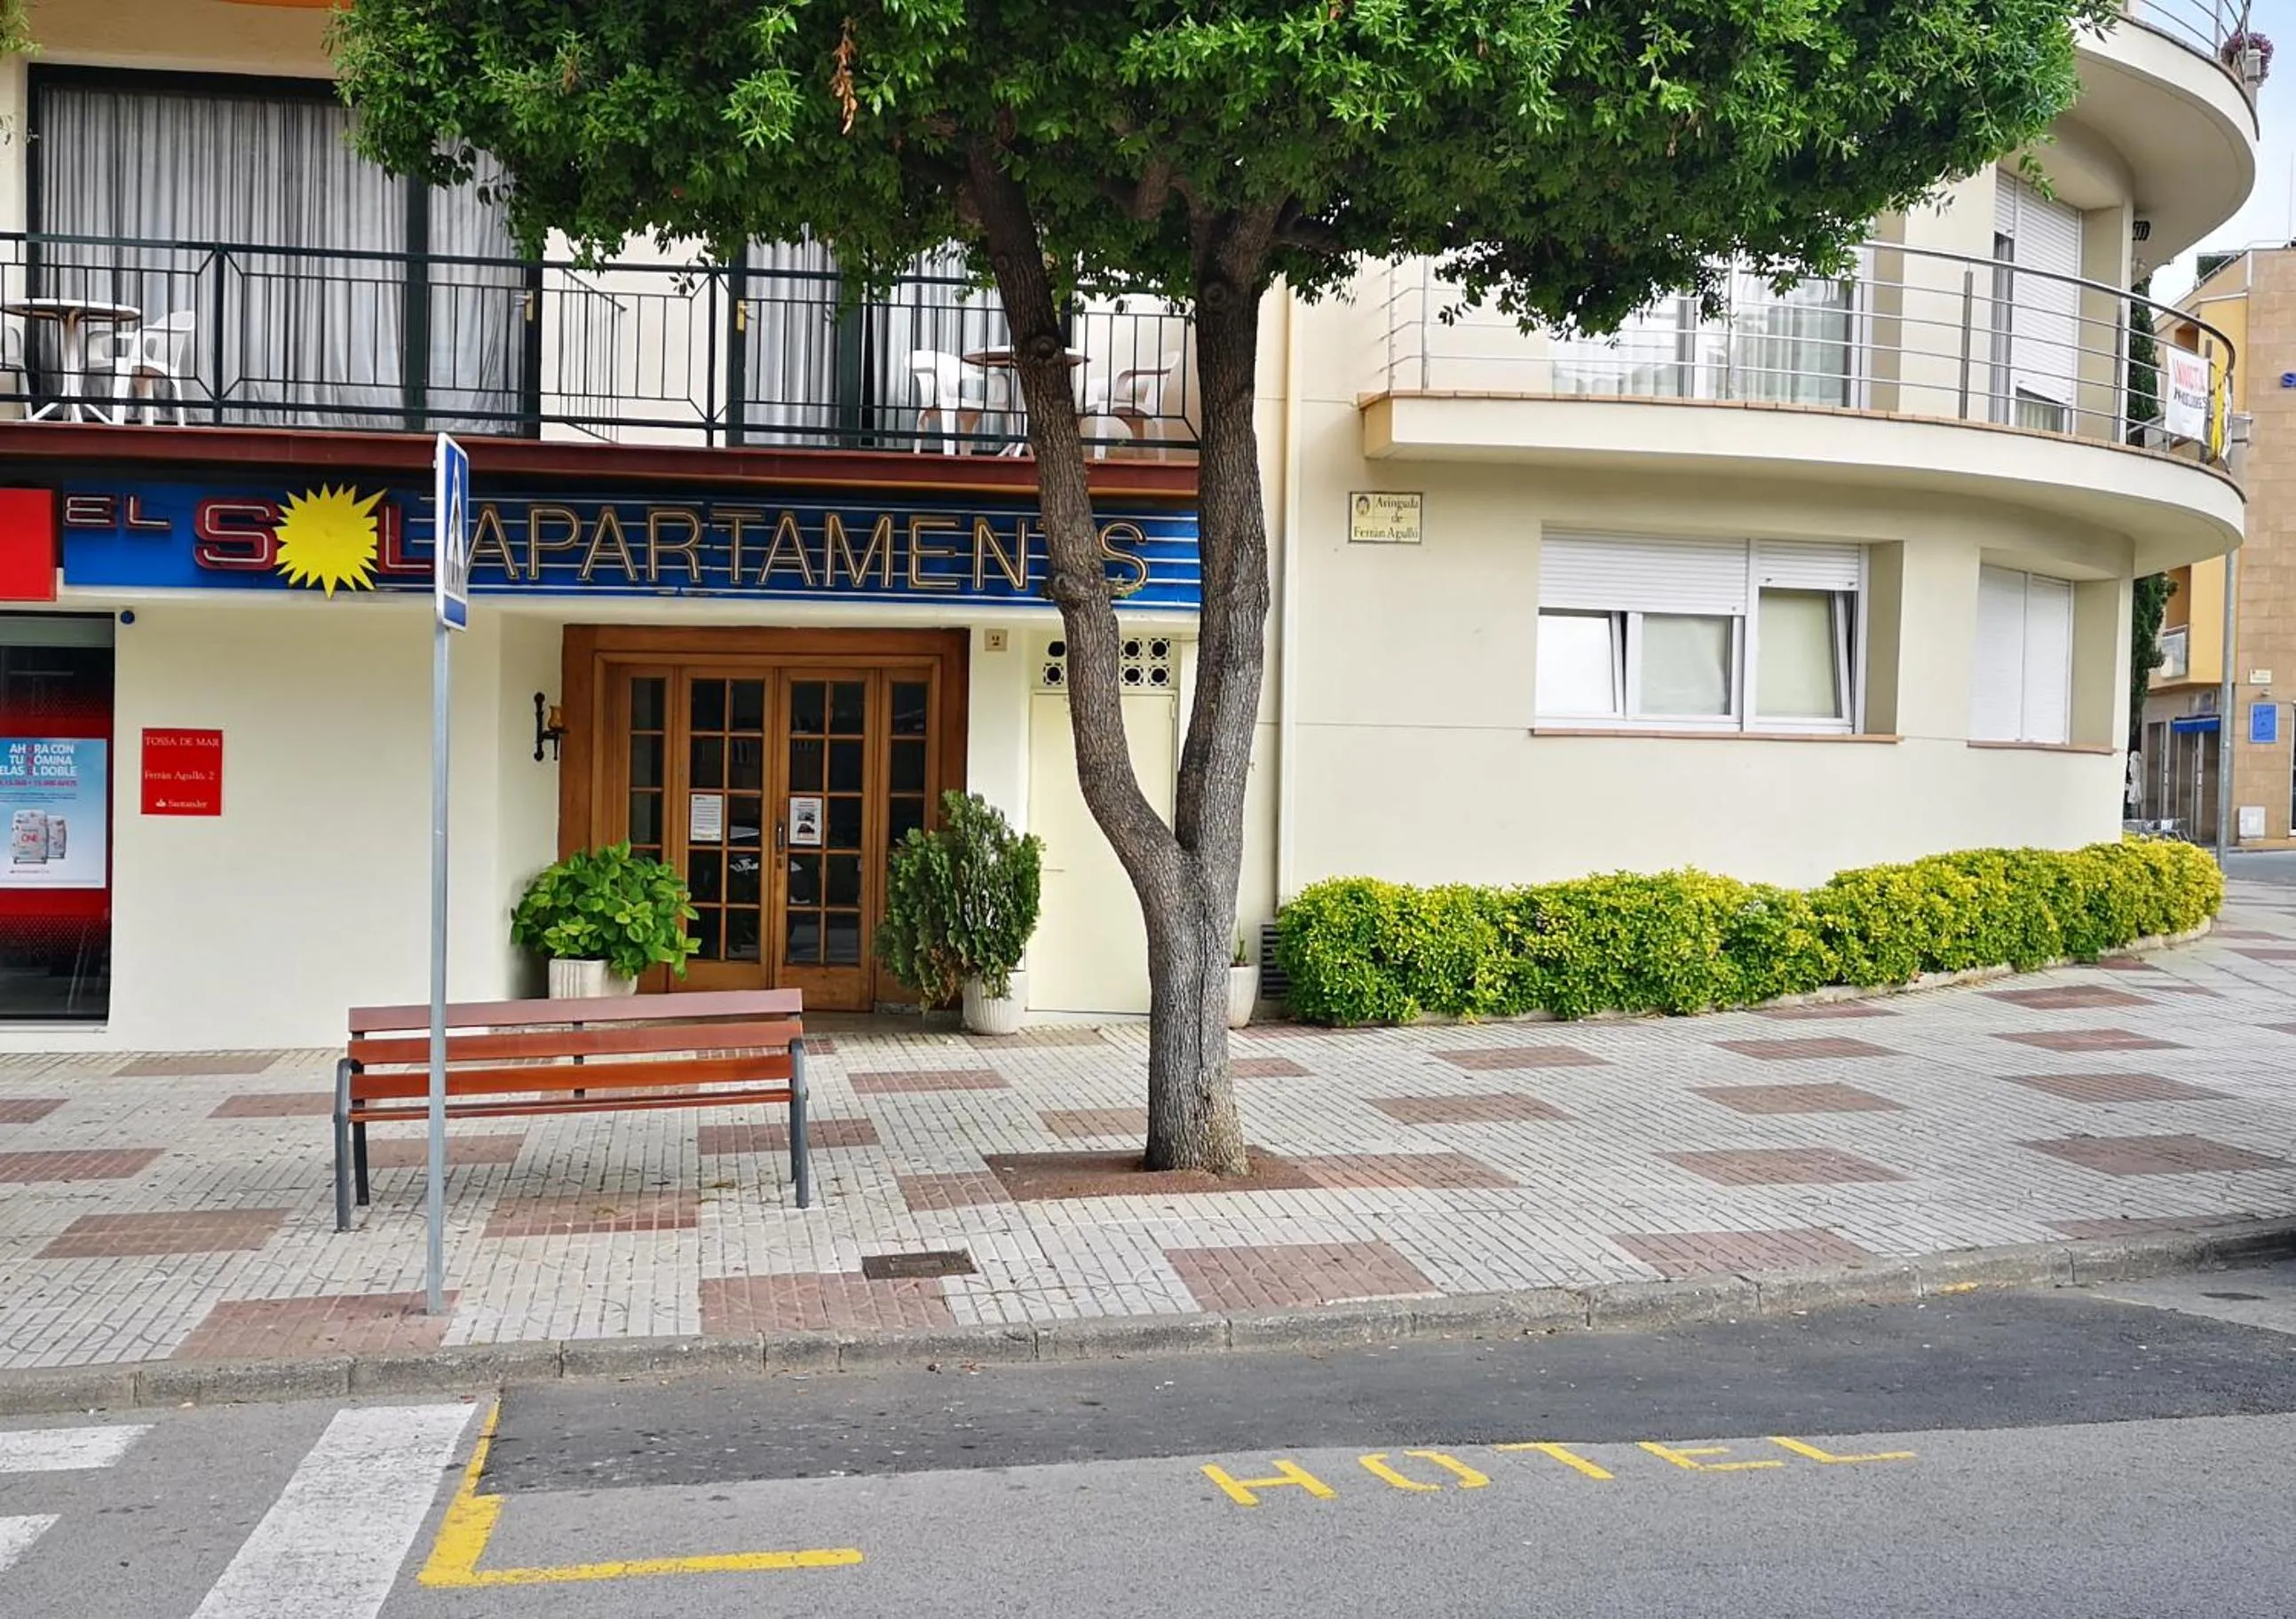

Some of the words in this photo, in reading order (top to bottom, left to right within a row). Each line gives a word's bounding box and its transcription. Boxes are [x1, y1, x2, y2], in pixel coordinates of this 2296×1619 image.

[1354, 525, 1385, 537] Ferran
[64, 493, 171, 530] EL
[467, 502, 1151, 598] APARTAMENS
[146, 736, 177, 746] TOSSA
[179, 737, 193, 746] DE
[196, 738, 219, 747] MAR
[51, 744, 75, 754] CON
[10, 754, 24, 764] TU
[41, 766, 77, 776] DOBLE
[168, 799, 209, 809] Santander
[1201, 1435, 1917, 1506] HOTEL
